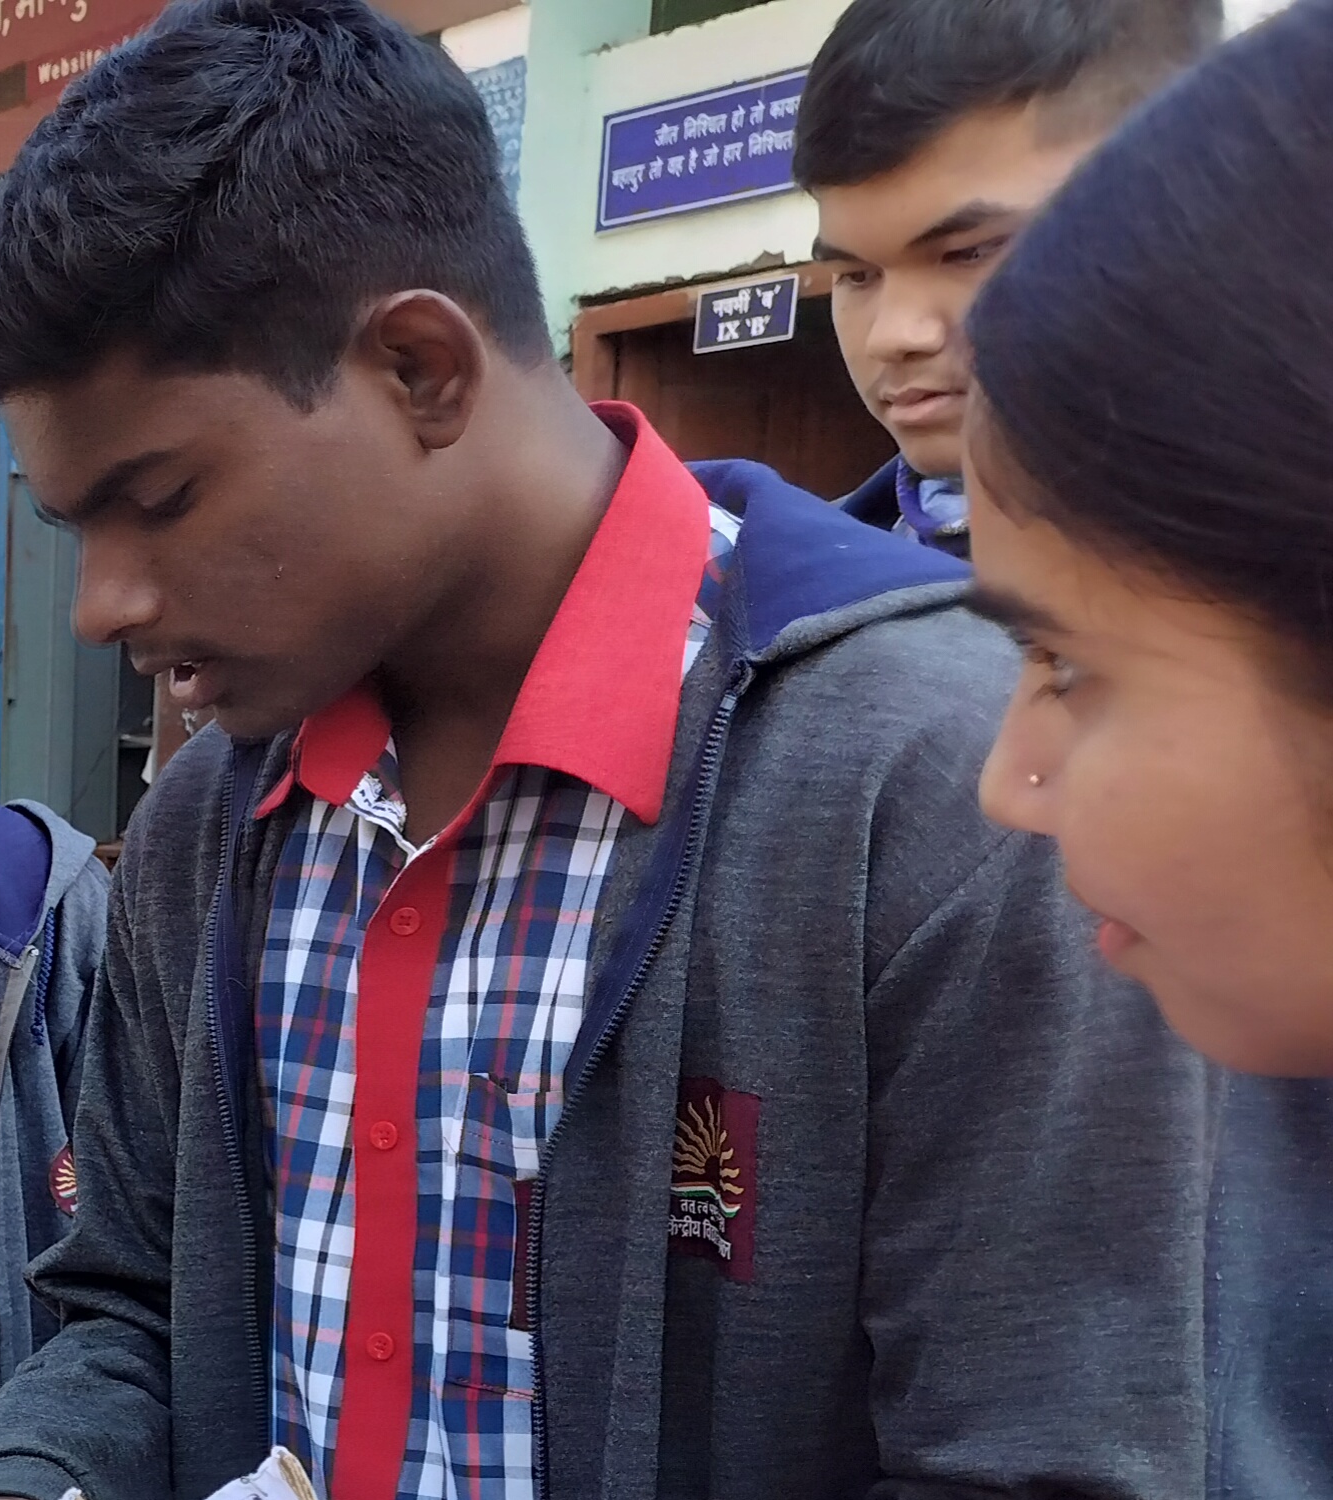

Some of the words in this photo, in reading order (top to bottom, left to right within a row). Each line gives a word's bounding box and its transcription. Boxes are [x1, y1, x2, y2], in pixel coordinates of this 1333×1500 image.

[749, 100, 765, 126] तो
[649, 155, 663, 181] तो
[716, 319, 740, 343] IX
